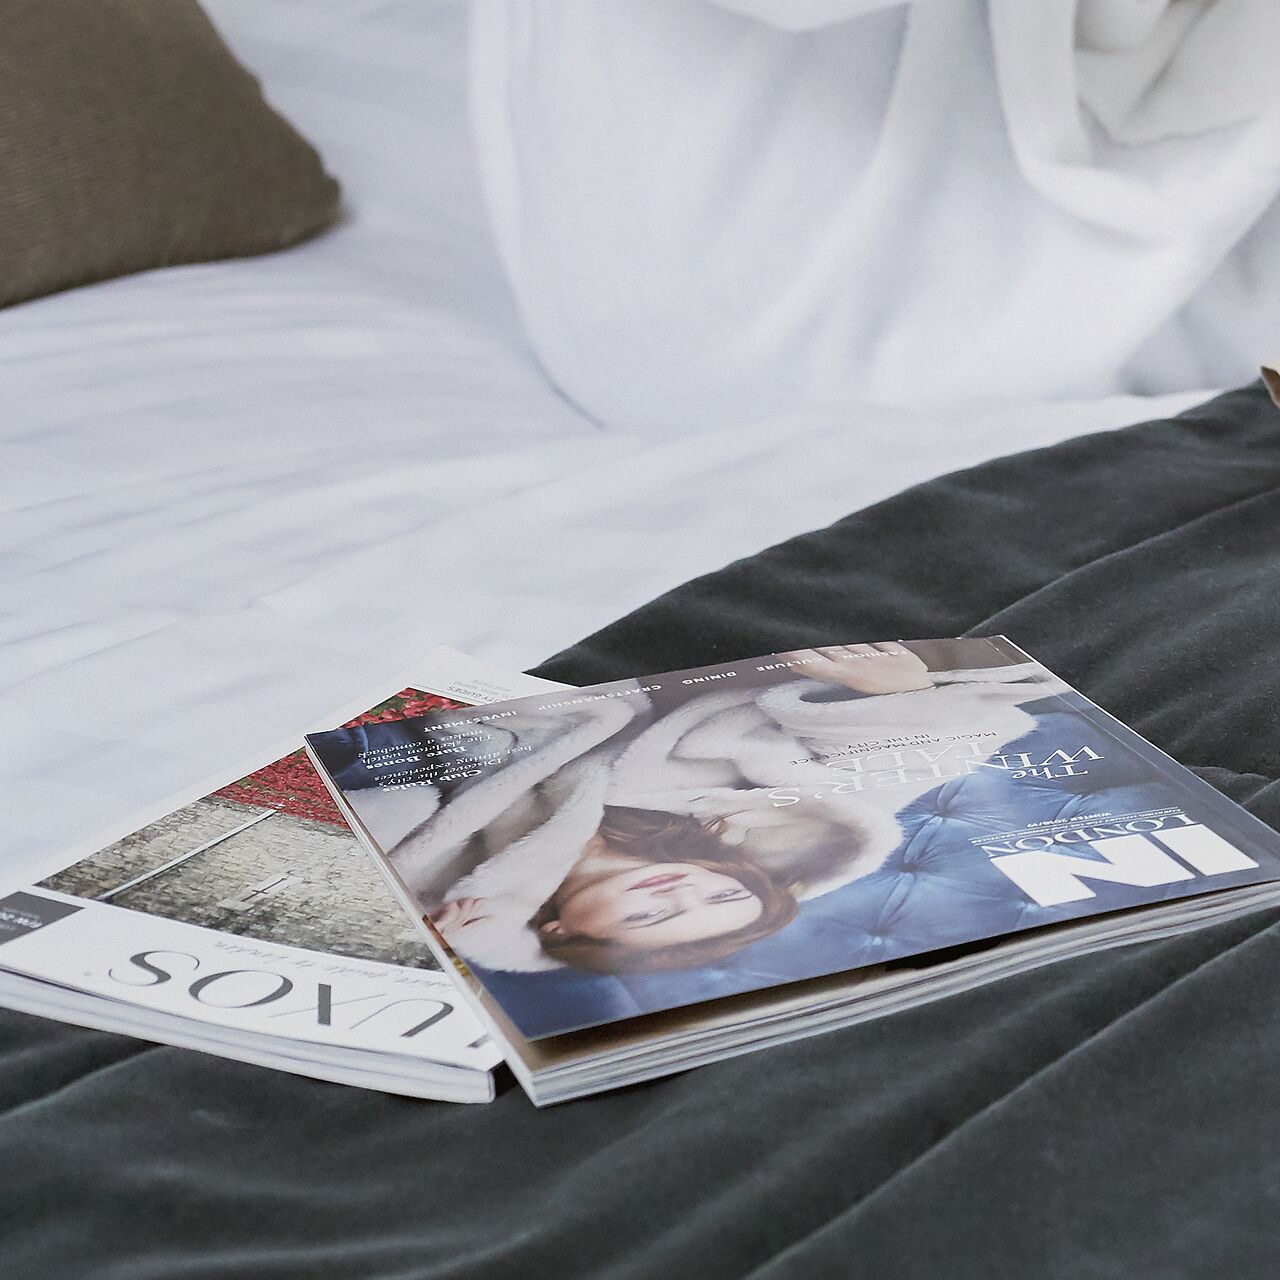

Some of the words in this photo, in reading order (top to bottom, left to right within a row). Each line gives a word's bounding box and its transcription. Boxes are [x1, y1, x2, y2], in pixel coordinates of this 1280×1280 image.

[756, 658, 822, 672] CULTURE
[682, 671, 736, 686] DINING
[538, 685, 661, 711] CRAFTSMANSHIP
[423, 710, 516, 733] INVESTMENT
[441, 730, 483, 742] makes
[467, 735, 491, 744] The
[882, 735, 911, 744] THE
[911, 737, 940, 747] AND
[945, 731, 996, 742] MAGIC
[358, 740, 421, 758] comeback
[408, 741, 460, 755] skeleton
[506, 745, 532, 754] best
[844, 738, 878, 750] CITY
[362, 751, 401, 765] watch
[427, 746, 465, 758] Bare
[456, 751, 500, 765] dining
[790, 739, 908, 766] MAGNIFICENCE
[826, 740, 999, 777] TALE
[366, 755, 419, 770] Bones
[443, 757, 501, 775] Discover
[374, 763, 450, 781] experiences
[417, 771, 437, 781] the
[439, 768, 482, 781] Club
[767, 744, 1104, 807] WINTER'S
[1010, 764, 1088, 780] The
[377, 775, 411, 789] city's
[382, 778, 433, 793] Rules
[981, 813, 1197, 857] LONDON
[989, 823, 1260, 908] IN
[108, 950, 493, 1049] UXOS
